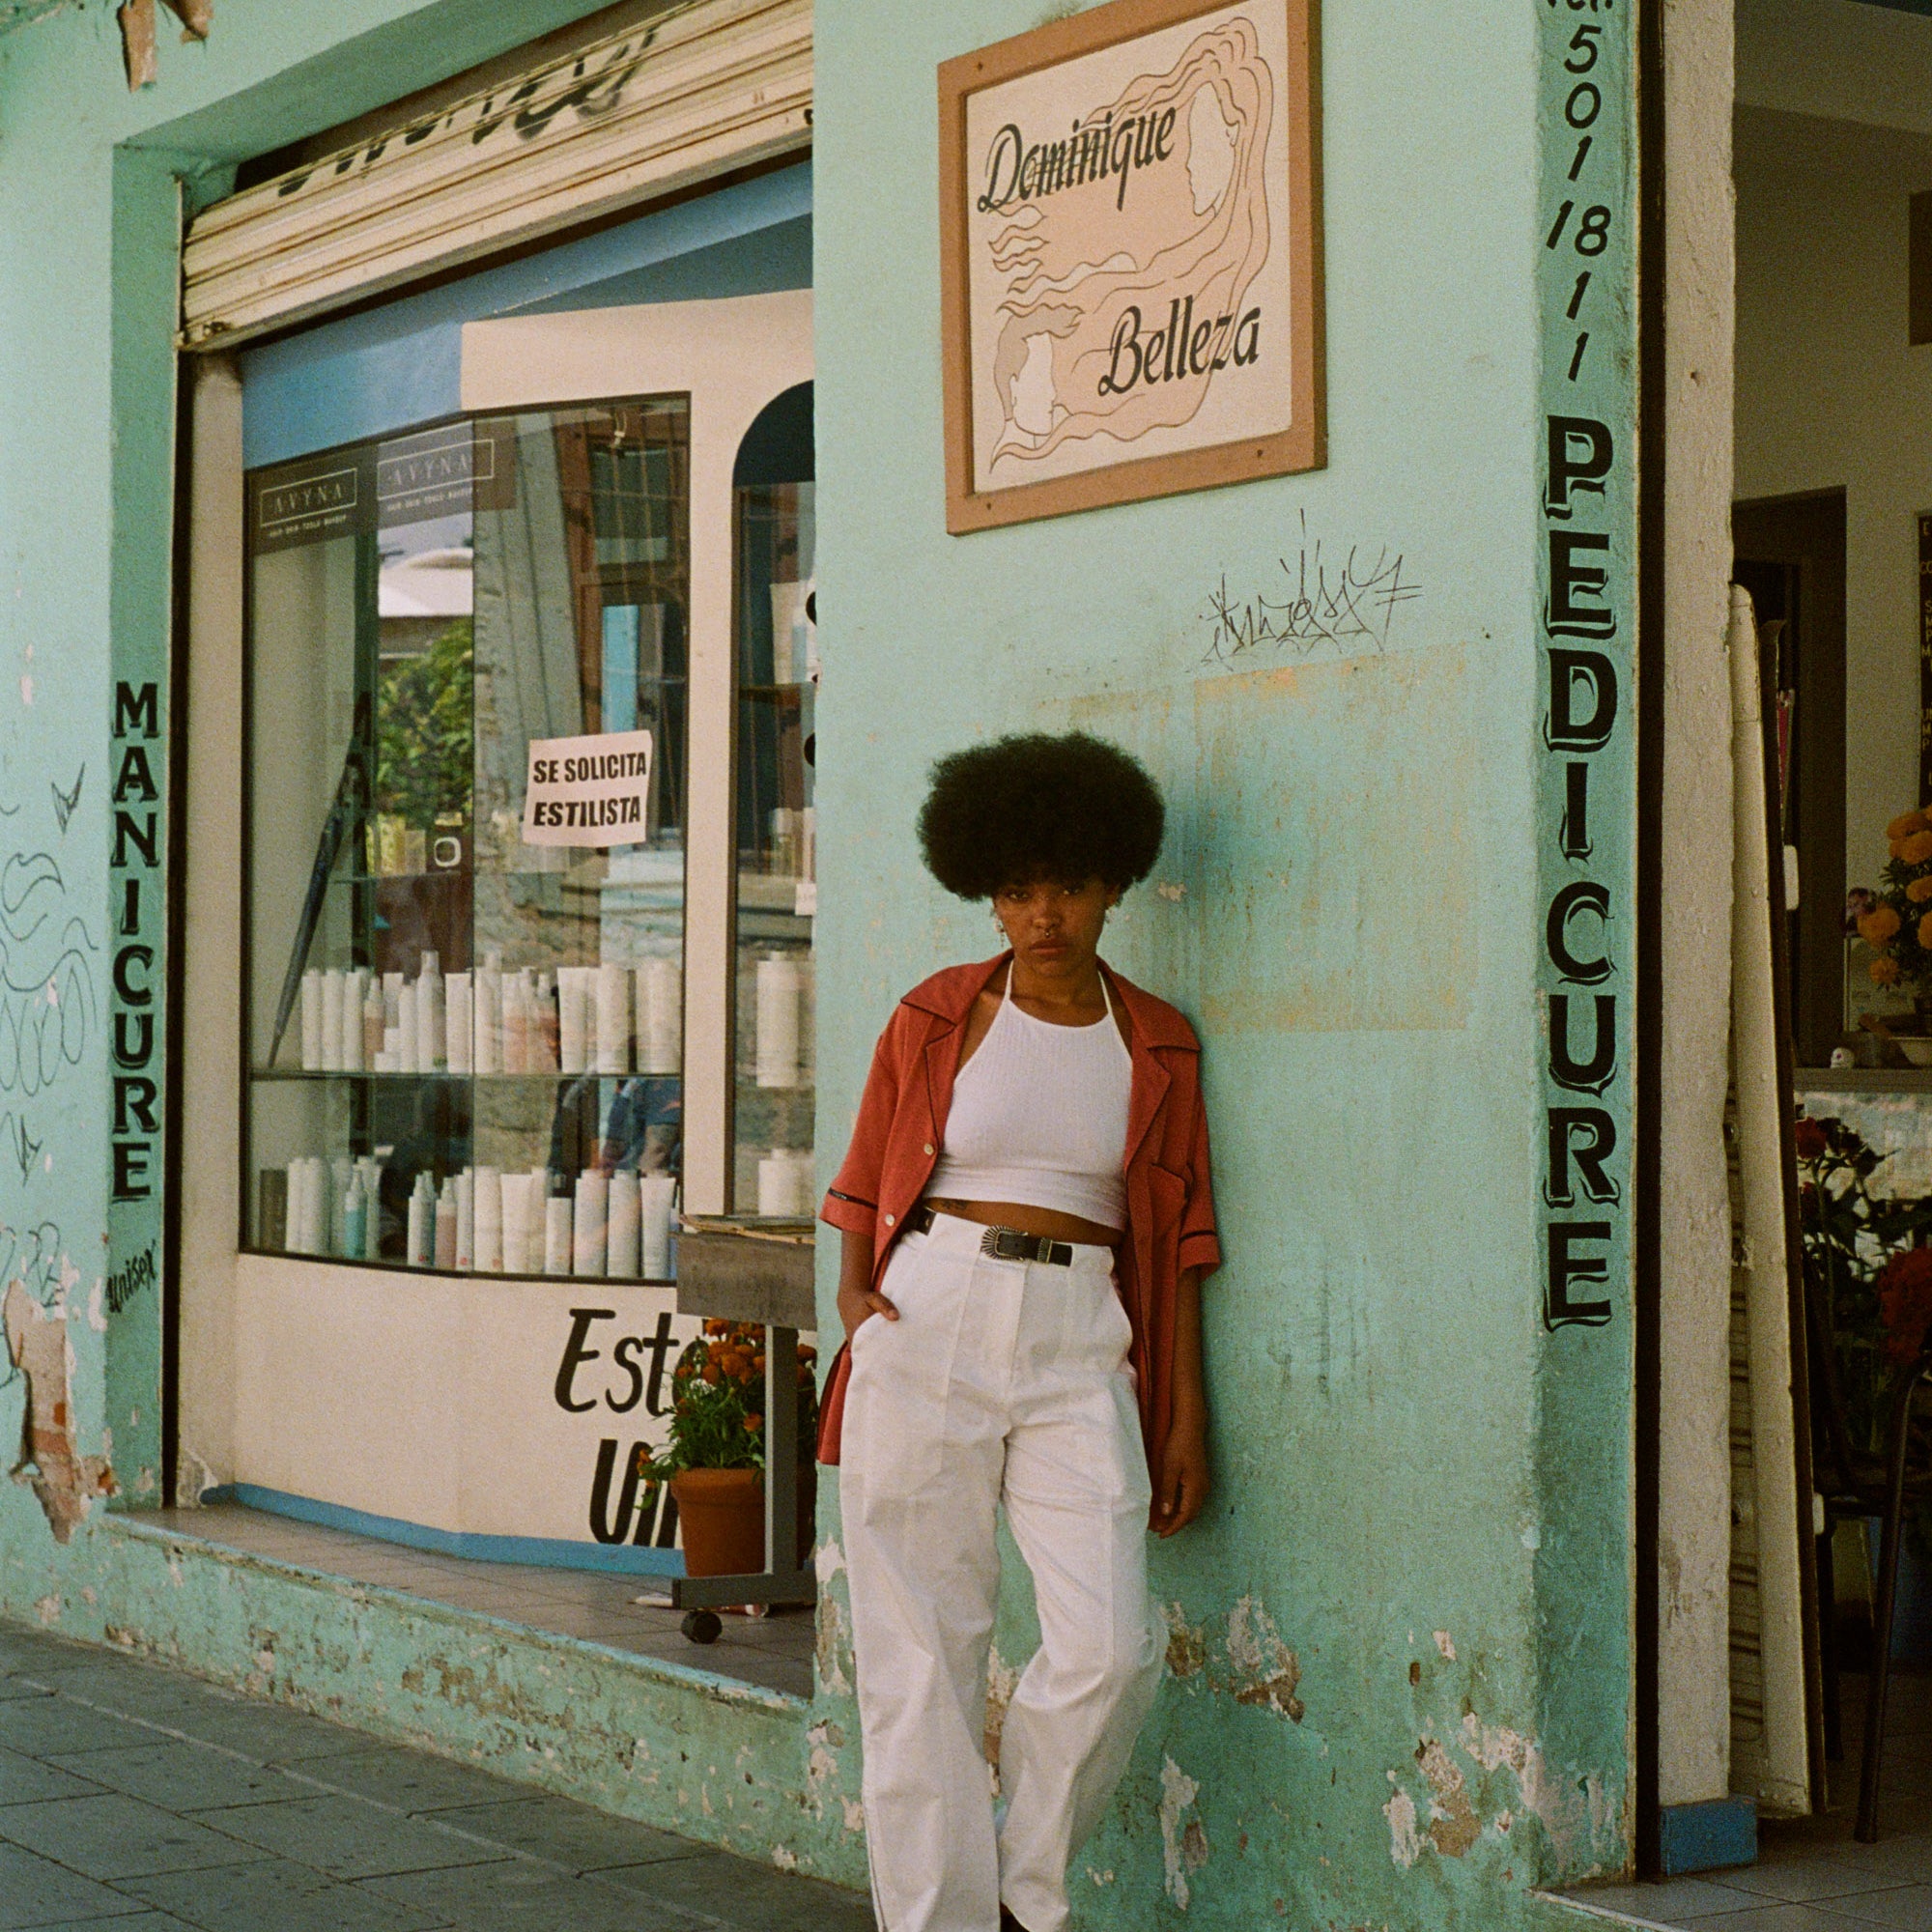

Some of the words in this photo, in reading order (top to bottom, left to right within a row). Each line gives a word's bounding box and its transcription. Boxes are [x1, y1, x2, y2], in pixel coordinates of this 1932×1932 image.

[979, 107, 1176, 212] Dominique
[1099, 296, 1260, 395] Belleza
[532, 795, 640, 827] ESTILISTA
[533, 759, 558, 783] SE
[564, 752, 646, 782] SOLICITA
[1543, 415, 1621, 1332] PEDICURE
[110, 681, 159, 1204] MANICURE
